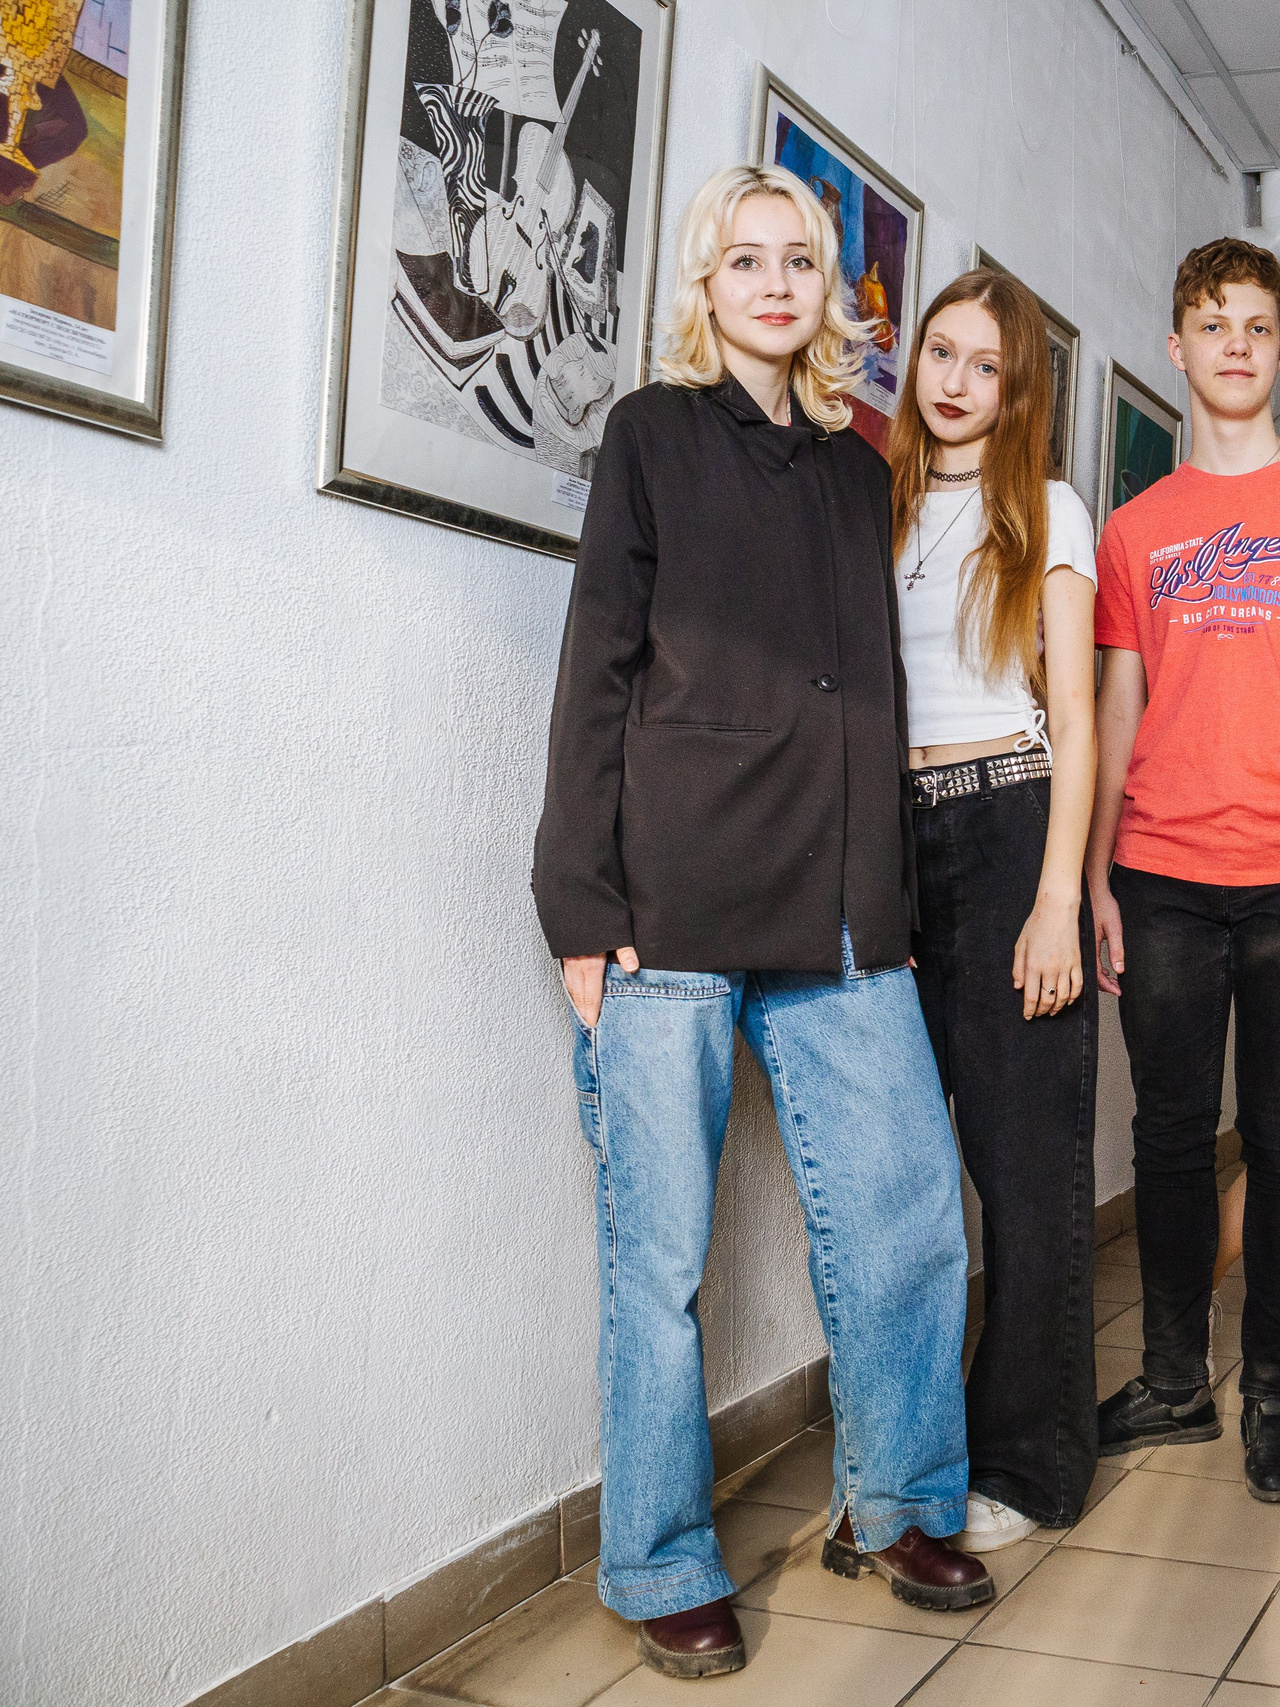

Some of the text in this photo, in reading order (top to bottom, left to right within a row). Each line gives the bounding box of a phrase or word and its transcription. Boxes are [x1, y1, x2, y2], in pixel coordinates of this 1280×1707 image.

[1150, 537, 1204, 560] CALIFORNIA STATE
[1151, 558, 1213, 609] Los
[1182, 605, 1272, 624] BIG CITY DREAMS
